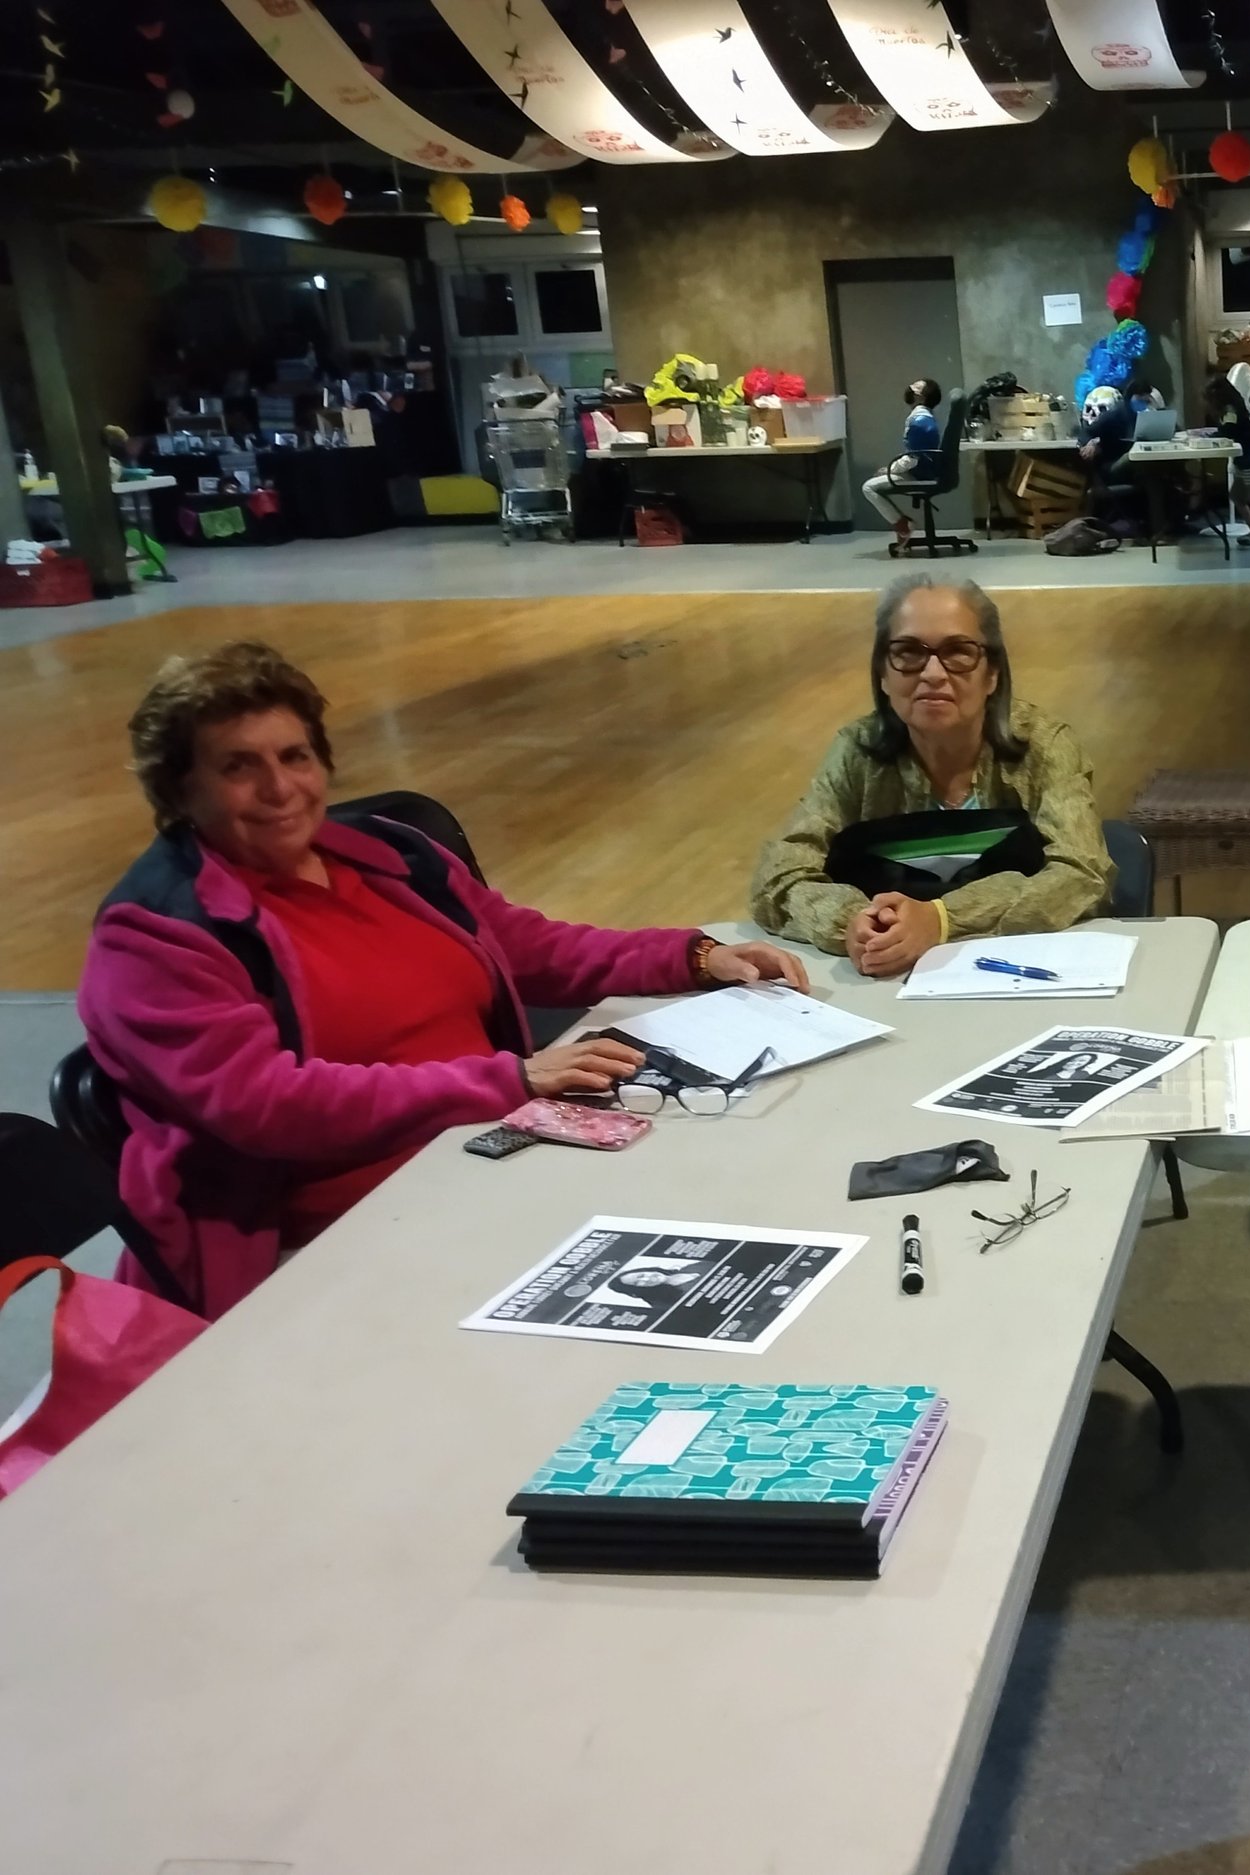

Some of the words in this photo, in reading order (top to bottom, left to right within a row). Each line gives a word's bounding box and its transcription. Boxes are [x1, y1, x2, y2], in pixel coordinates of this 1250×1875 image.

[1056, 1031, 1130, 1042] OPERATION
[493, 1266, 573, 1318] OPERATION
[559, 1231, 612, 1265] GOBBLE
